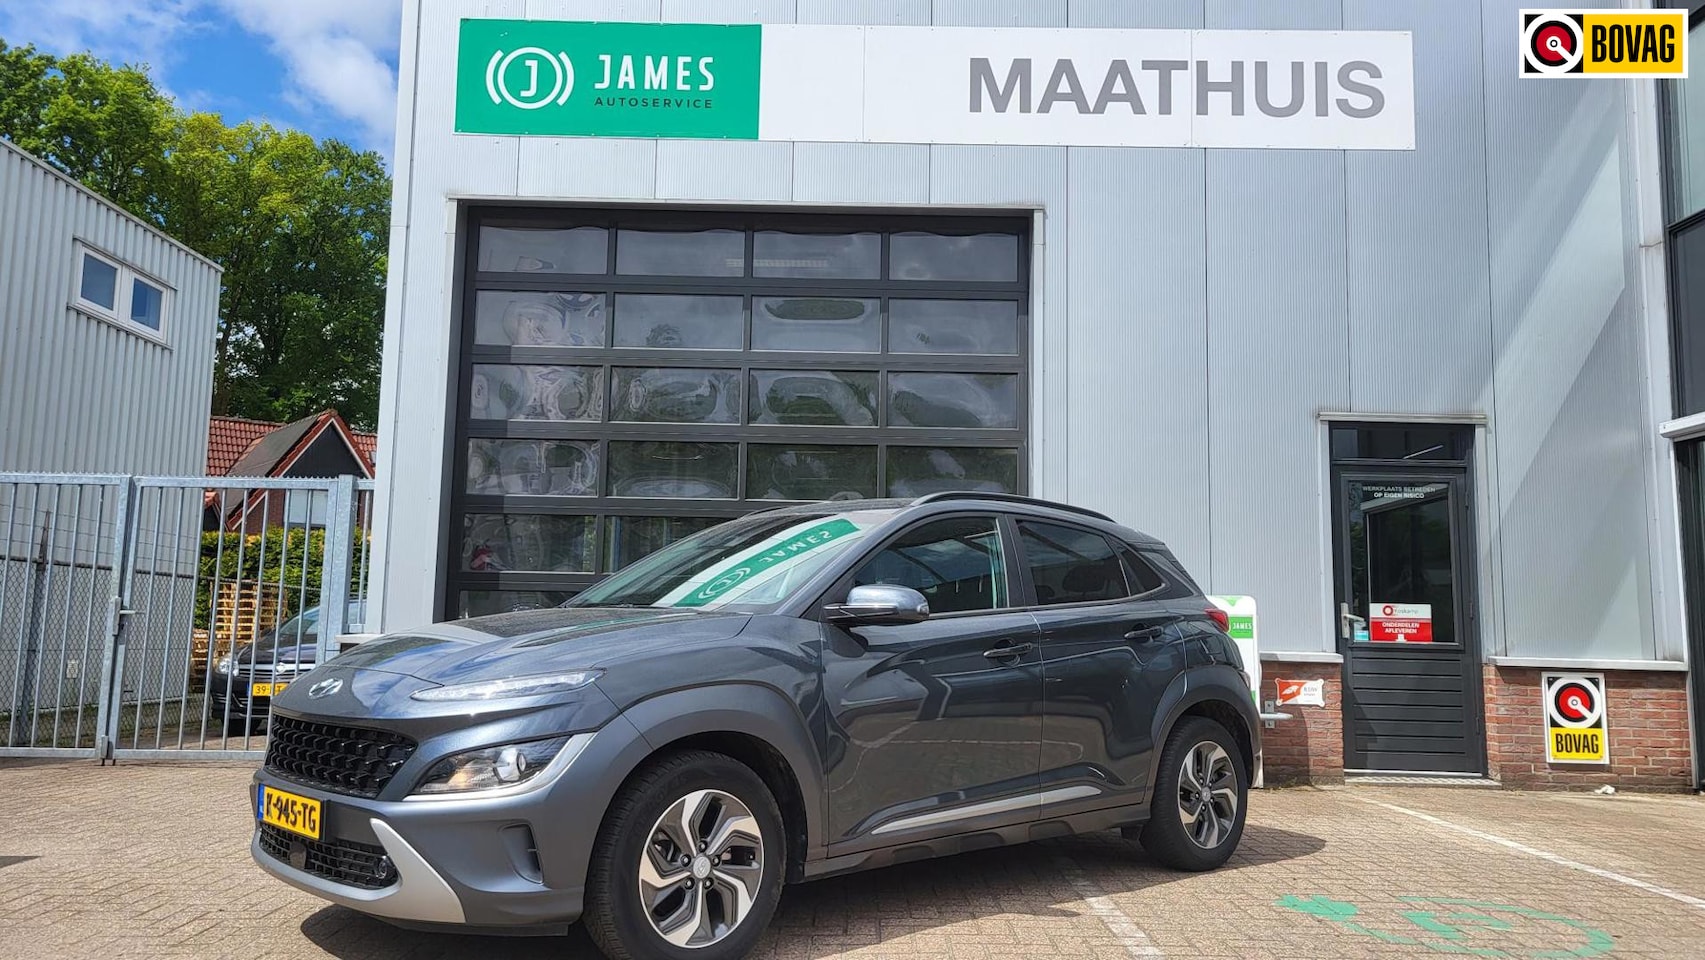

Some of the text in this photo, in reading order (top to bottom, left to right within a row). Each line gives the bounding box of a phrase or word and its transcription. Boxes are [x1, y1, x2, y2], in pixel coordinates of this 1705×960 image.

[520, 59, 538, 97] J
[594, 54, 715, 91] JAMES
[969, 57, 1386, 118] MAATHUIS
[594, 96, 713, 108] AUTOSERVICE
[1232, 622, 1252, 630] JAMES
[1555, 733, 1599, 754] BOVAG
[266, 792, 317, 833] K-945-TG
